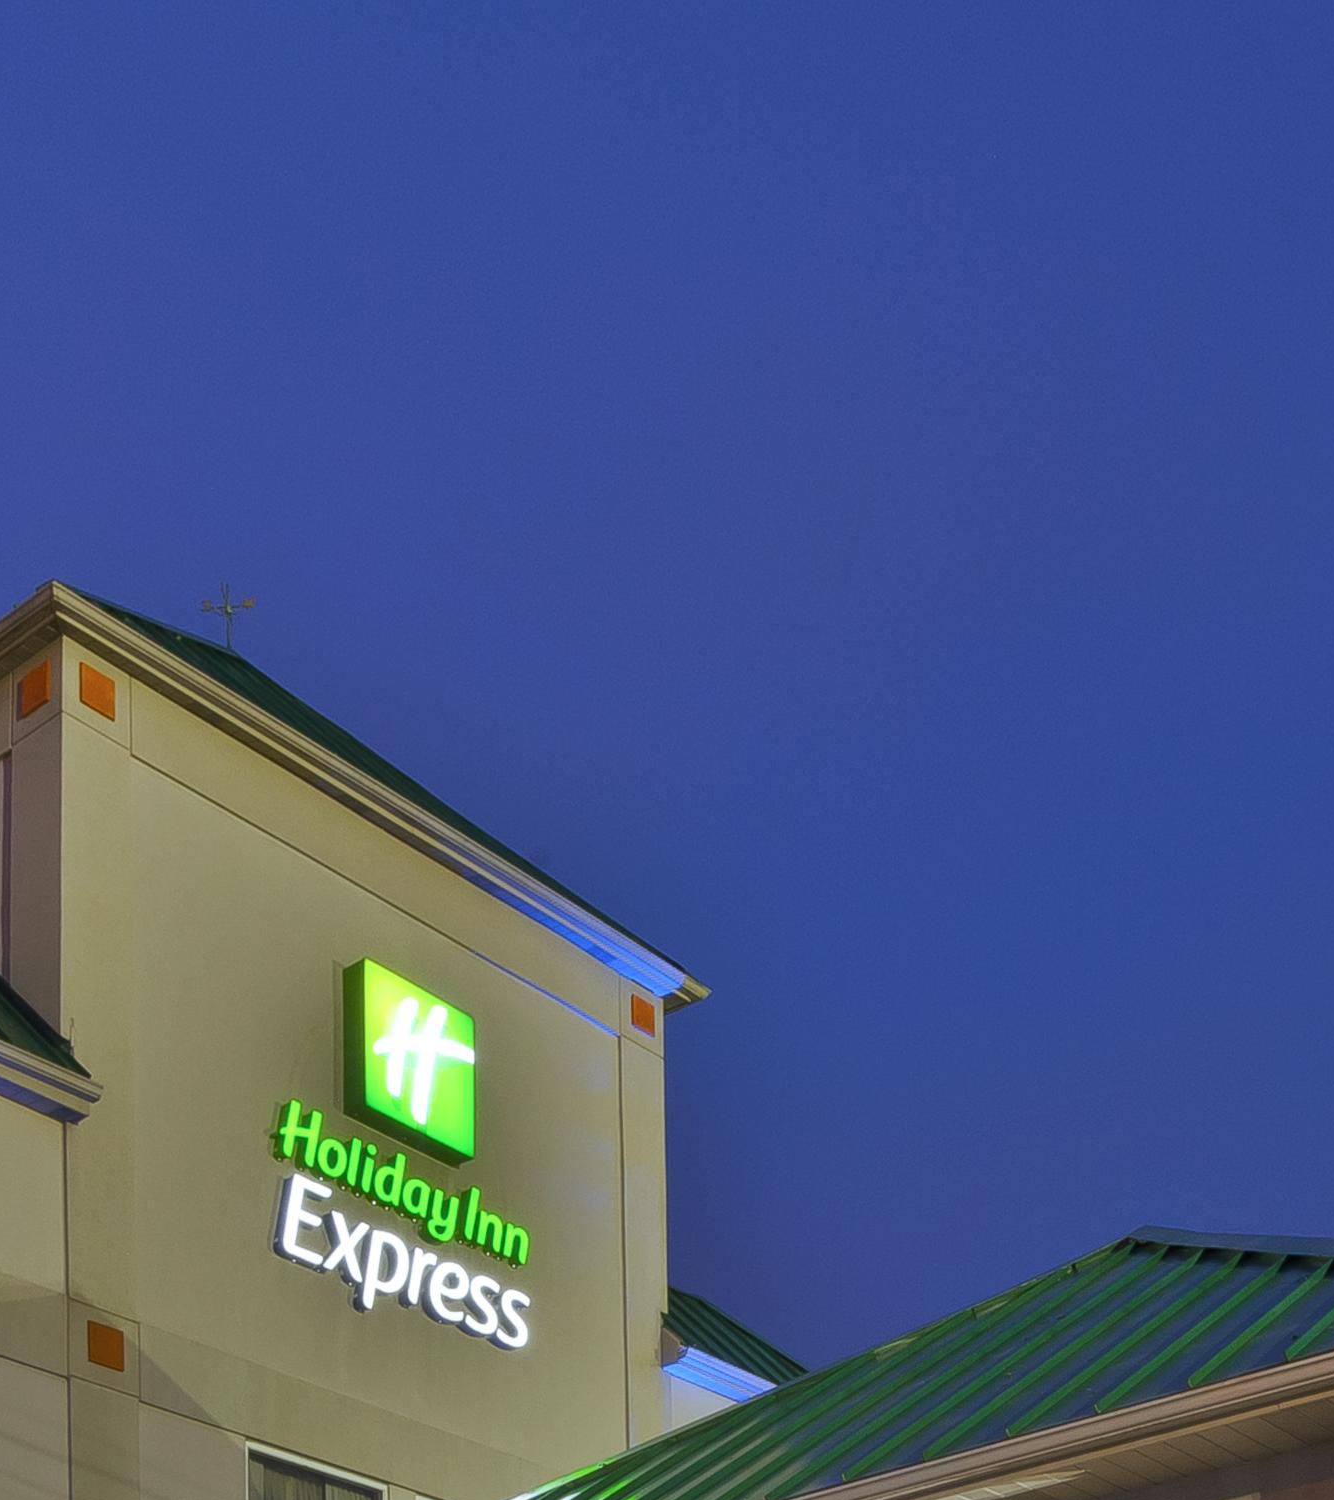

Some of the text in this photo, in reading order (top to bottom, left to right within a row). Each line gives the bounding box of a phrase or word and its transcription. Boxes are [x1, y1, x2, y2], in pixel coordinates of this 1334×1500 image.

[279, 1099, 530, 1265] Holiday Inn
[280, 1173, 531, 1348] Express
